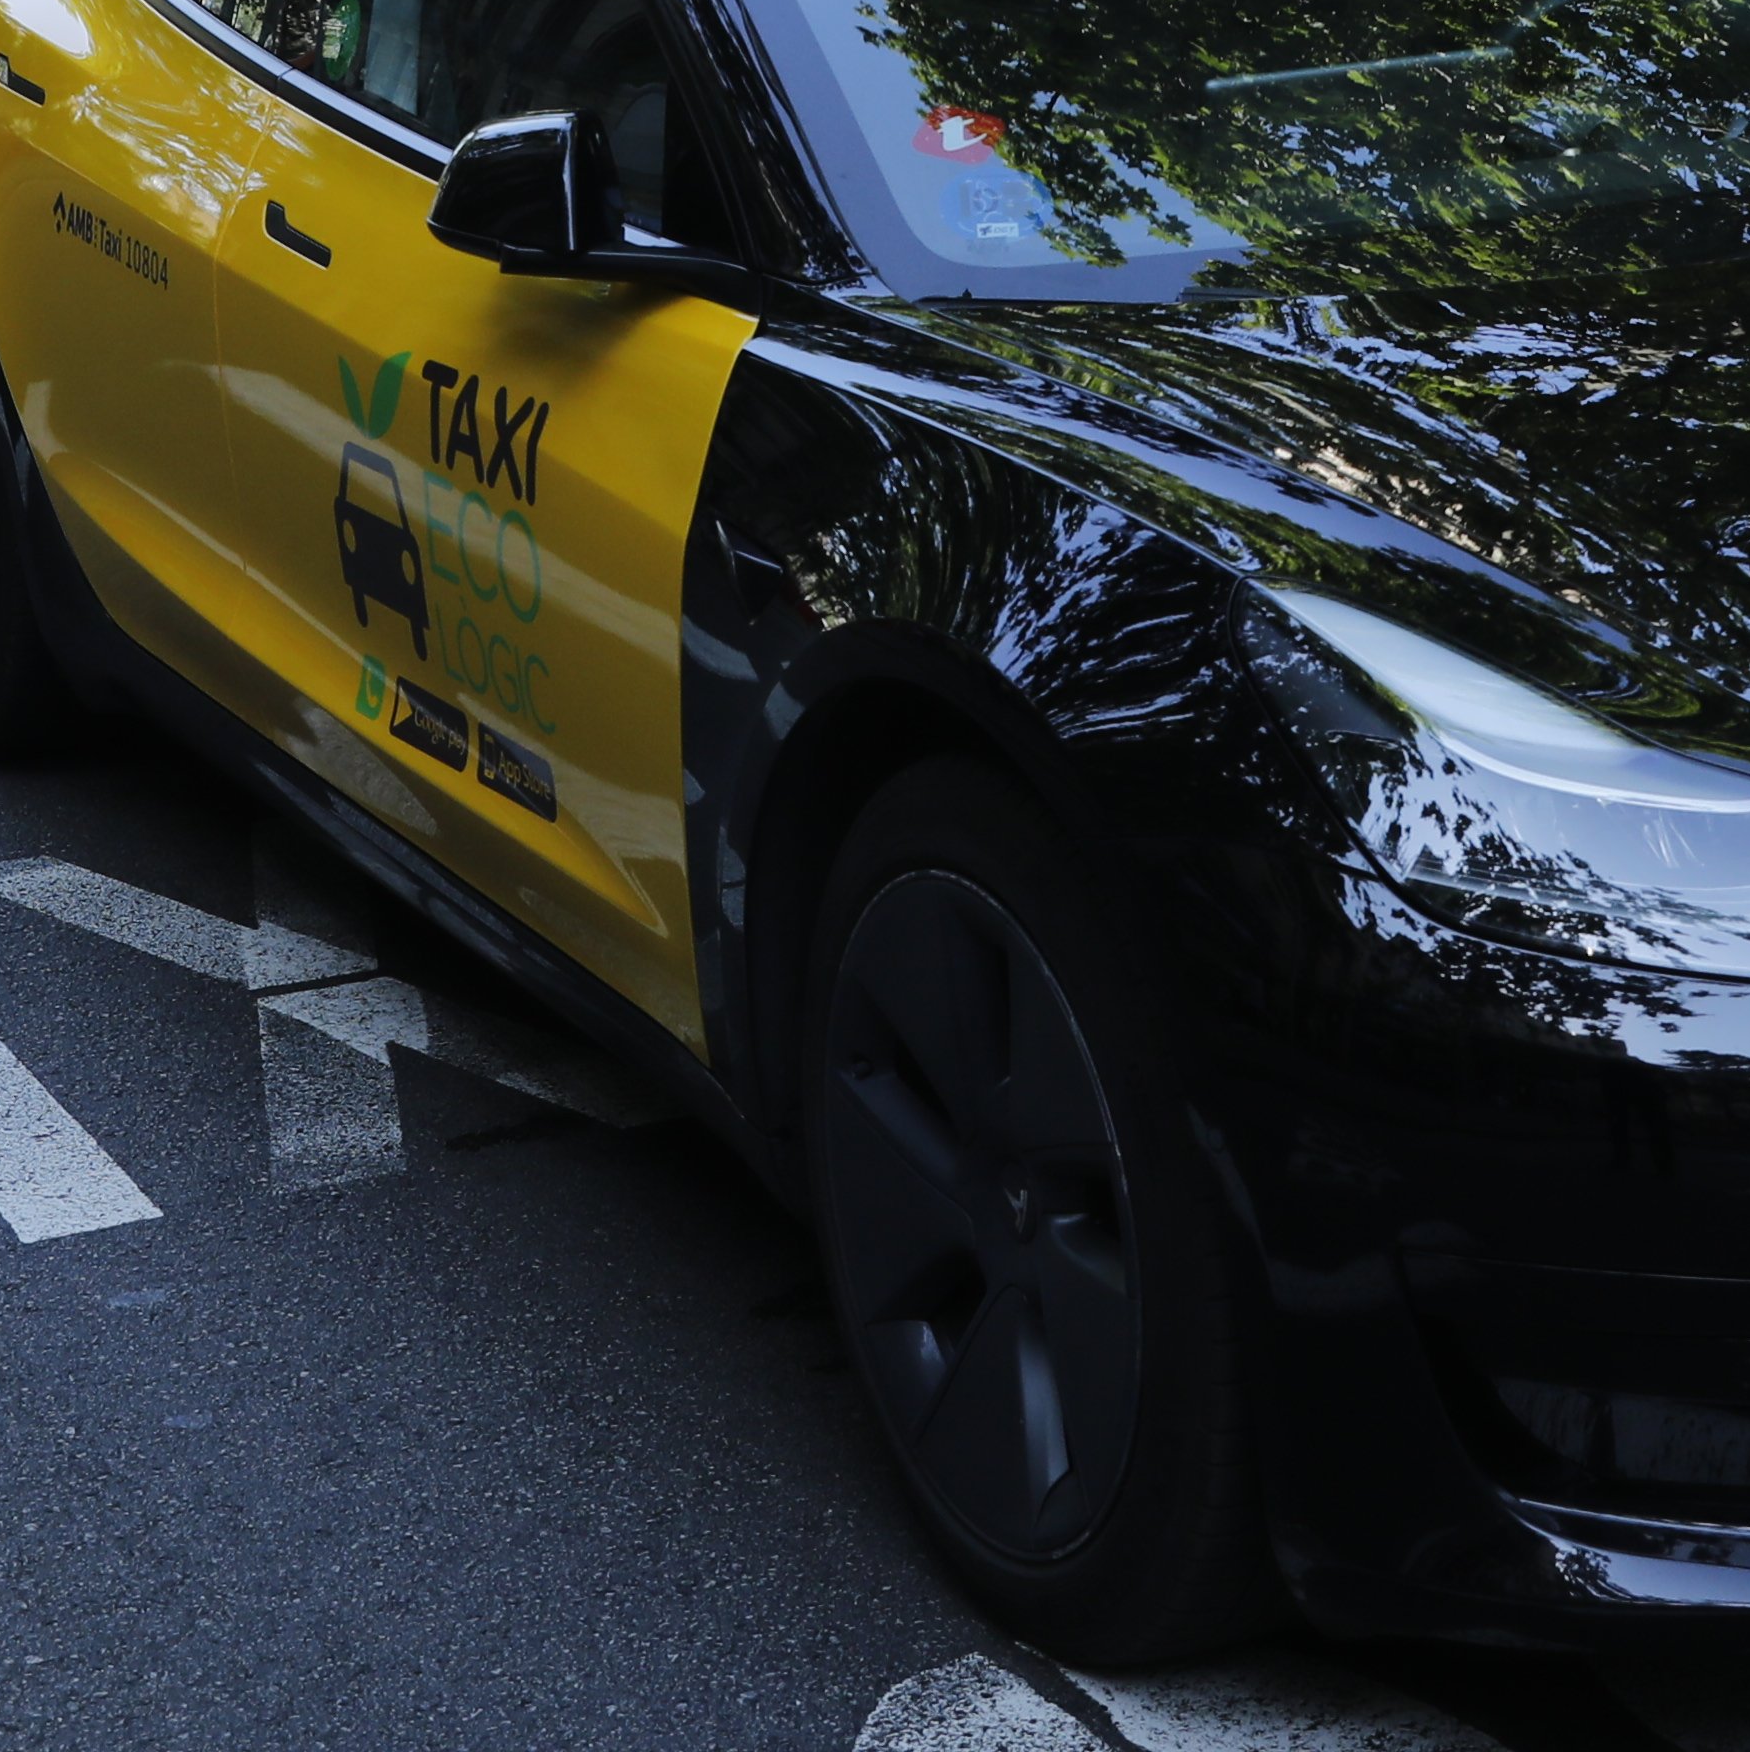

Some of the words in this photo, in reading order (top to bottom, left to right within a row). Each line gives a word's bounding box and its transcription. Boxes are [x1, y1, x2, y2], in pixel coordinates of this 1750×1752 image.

[66, 202, 94, 245] AMB
[99, 218, 123, 263] Taxi
[125, 236, 169, 291] 10804
[422, 358, 550, 507] TAXI
[423, 469, 542, 624] ECO
[414, 705, 446, 745] Google
[447, 728, 468, 756] play
[500, 750, 521, 789] App
[522, 762, 552, 801] Store
